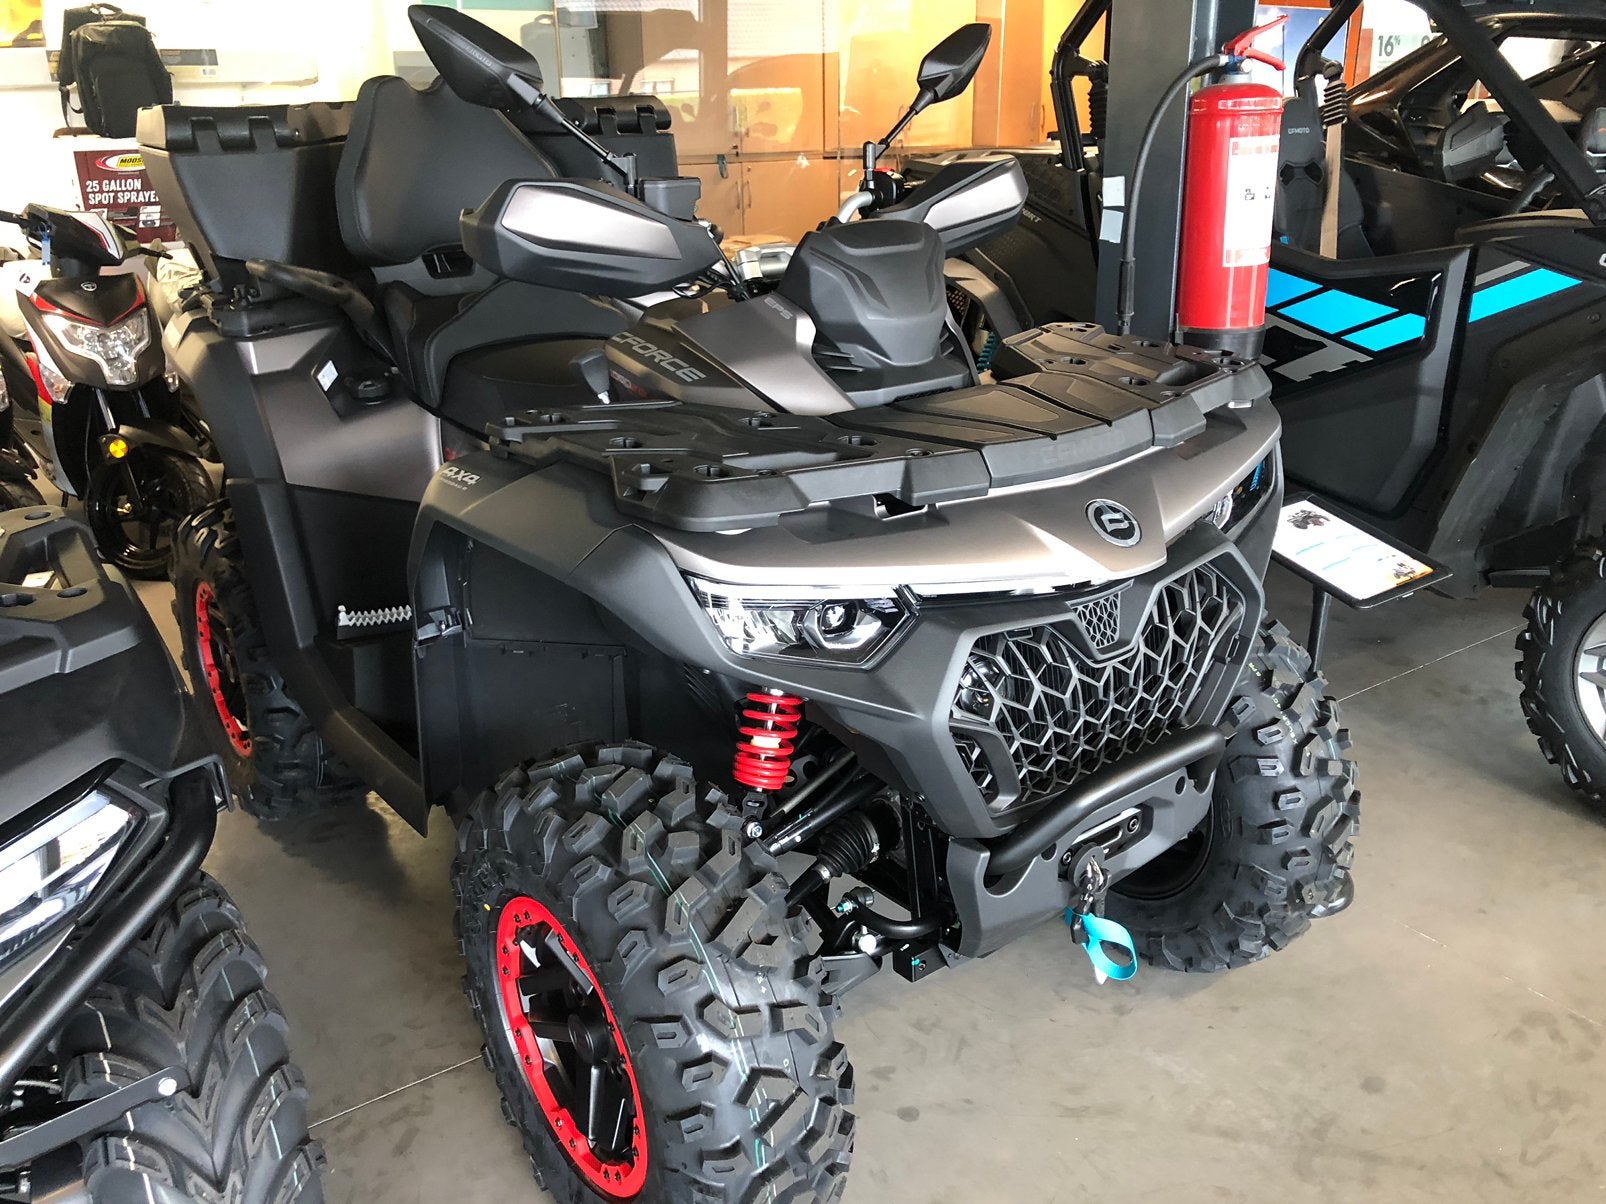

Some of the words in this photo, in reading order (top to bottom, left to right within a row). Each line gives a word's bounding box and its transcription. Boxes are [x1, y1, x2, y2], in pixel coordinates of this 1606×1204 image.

[86, 181, 99, 192] 25
[102, 179, 141, 191] GALLON
[88, 192, 115, 205] SPOT
[117, 190, 159, 204] SPRAYE
[764, 297, 794, 320] EPS
[611, 331, 708, 383] CFORCE
